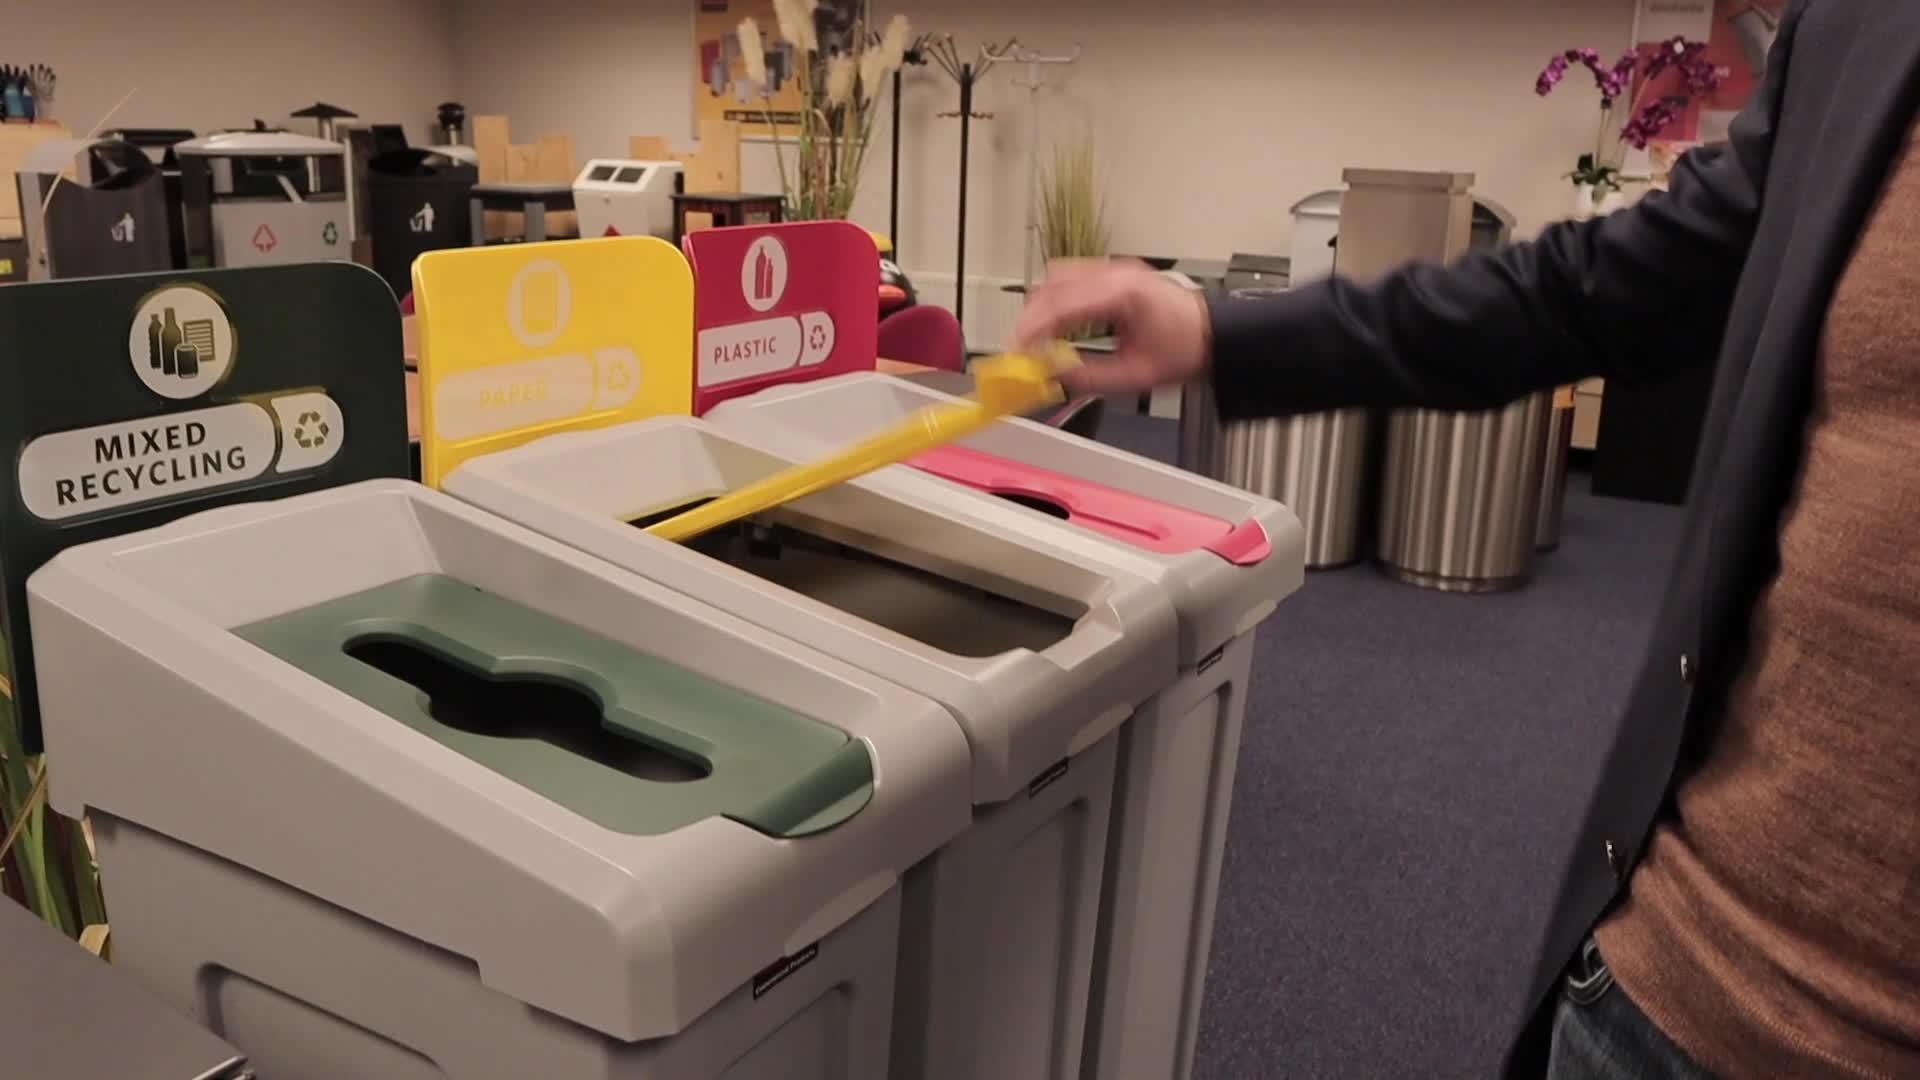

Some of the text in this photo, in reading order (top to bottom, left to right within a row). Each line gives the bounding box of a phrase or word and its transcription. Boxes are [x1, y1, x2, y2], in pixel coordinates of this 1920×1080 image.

[714, 336, 776, 365] PLASTIC
[95, 422, 206, 464] MIXED
[56, 446, 246, 505] RECYCLING
